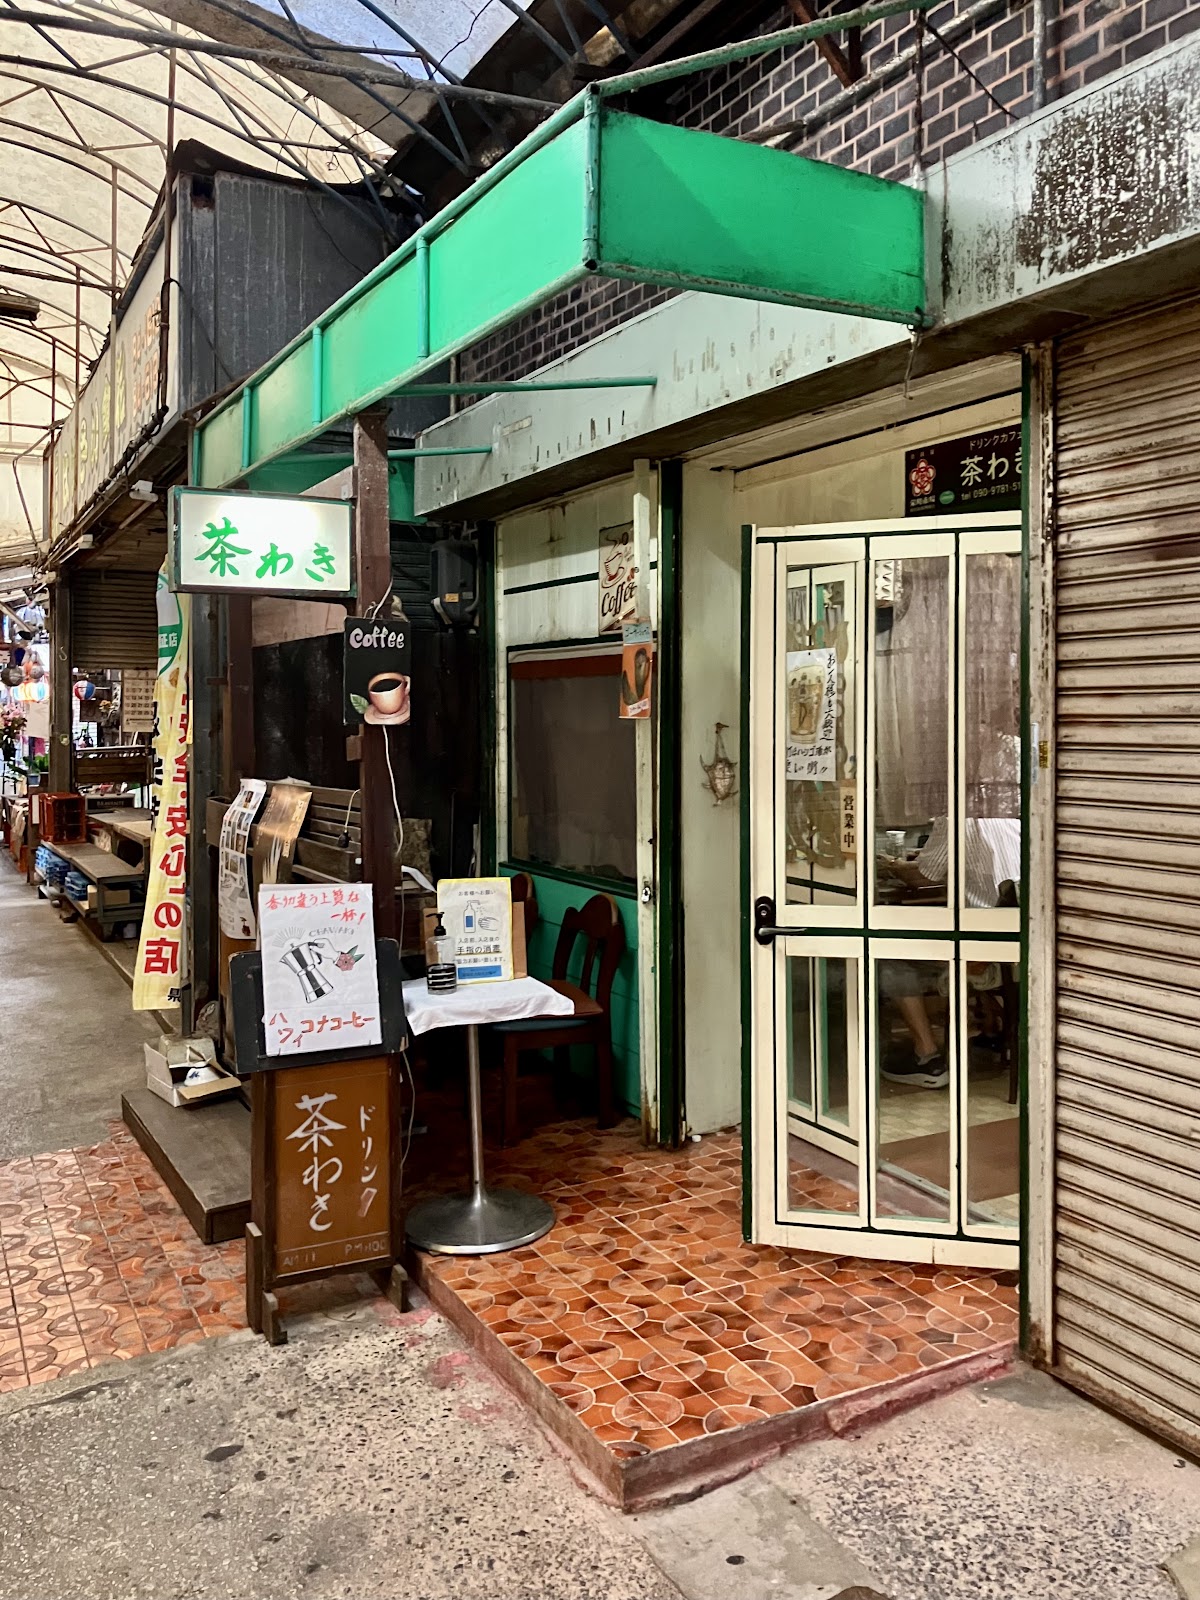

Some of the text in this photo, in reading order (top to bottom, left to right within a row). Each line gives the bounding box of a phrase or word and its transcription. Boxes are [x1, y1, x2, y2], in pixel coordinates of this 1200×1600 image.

[961, 491, 971, 501] tel
[194, 517, 336, 582] 茶わき
[601, 580, 637, 617] Coffee
[350, 626, 405, 649] Coffee
[843, 794, 855, 848] 営業中
[308, 926, 355, 937] CHAWAKI
[457, 944, 501, 954] 手指の消毒
[285, 1092, 347, 1232] 茶わき
[358, 1105, 378, 1217] ドリンク
